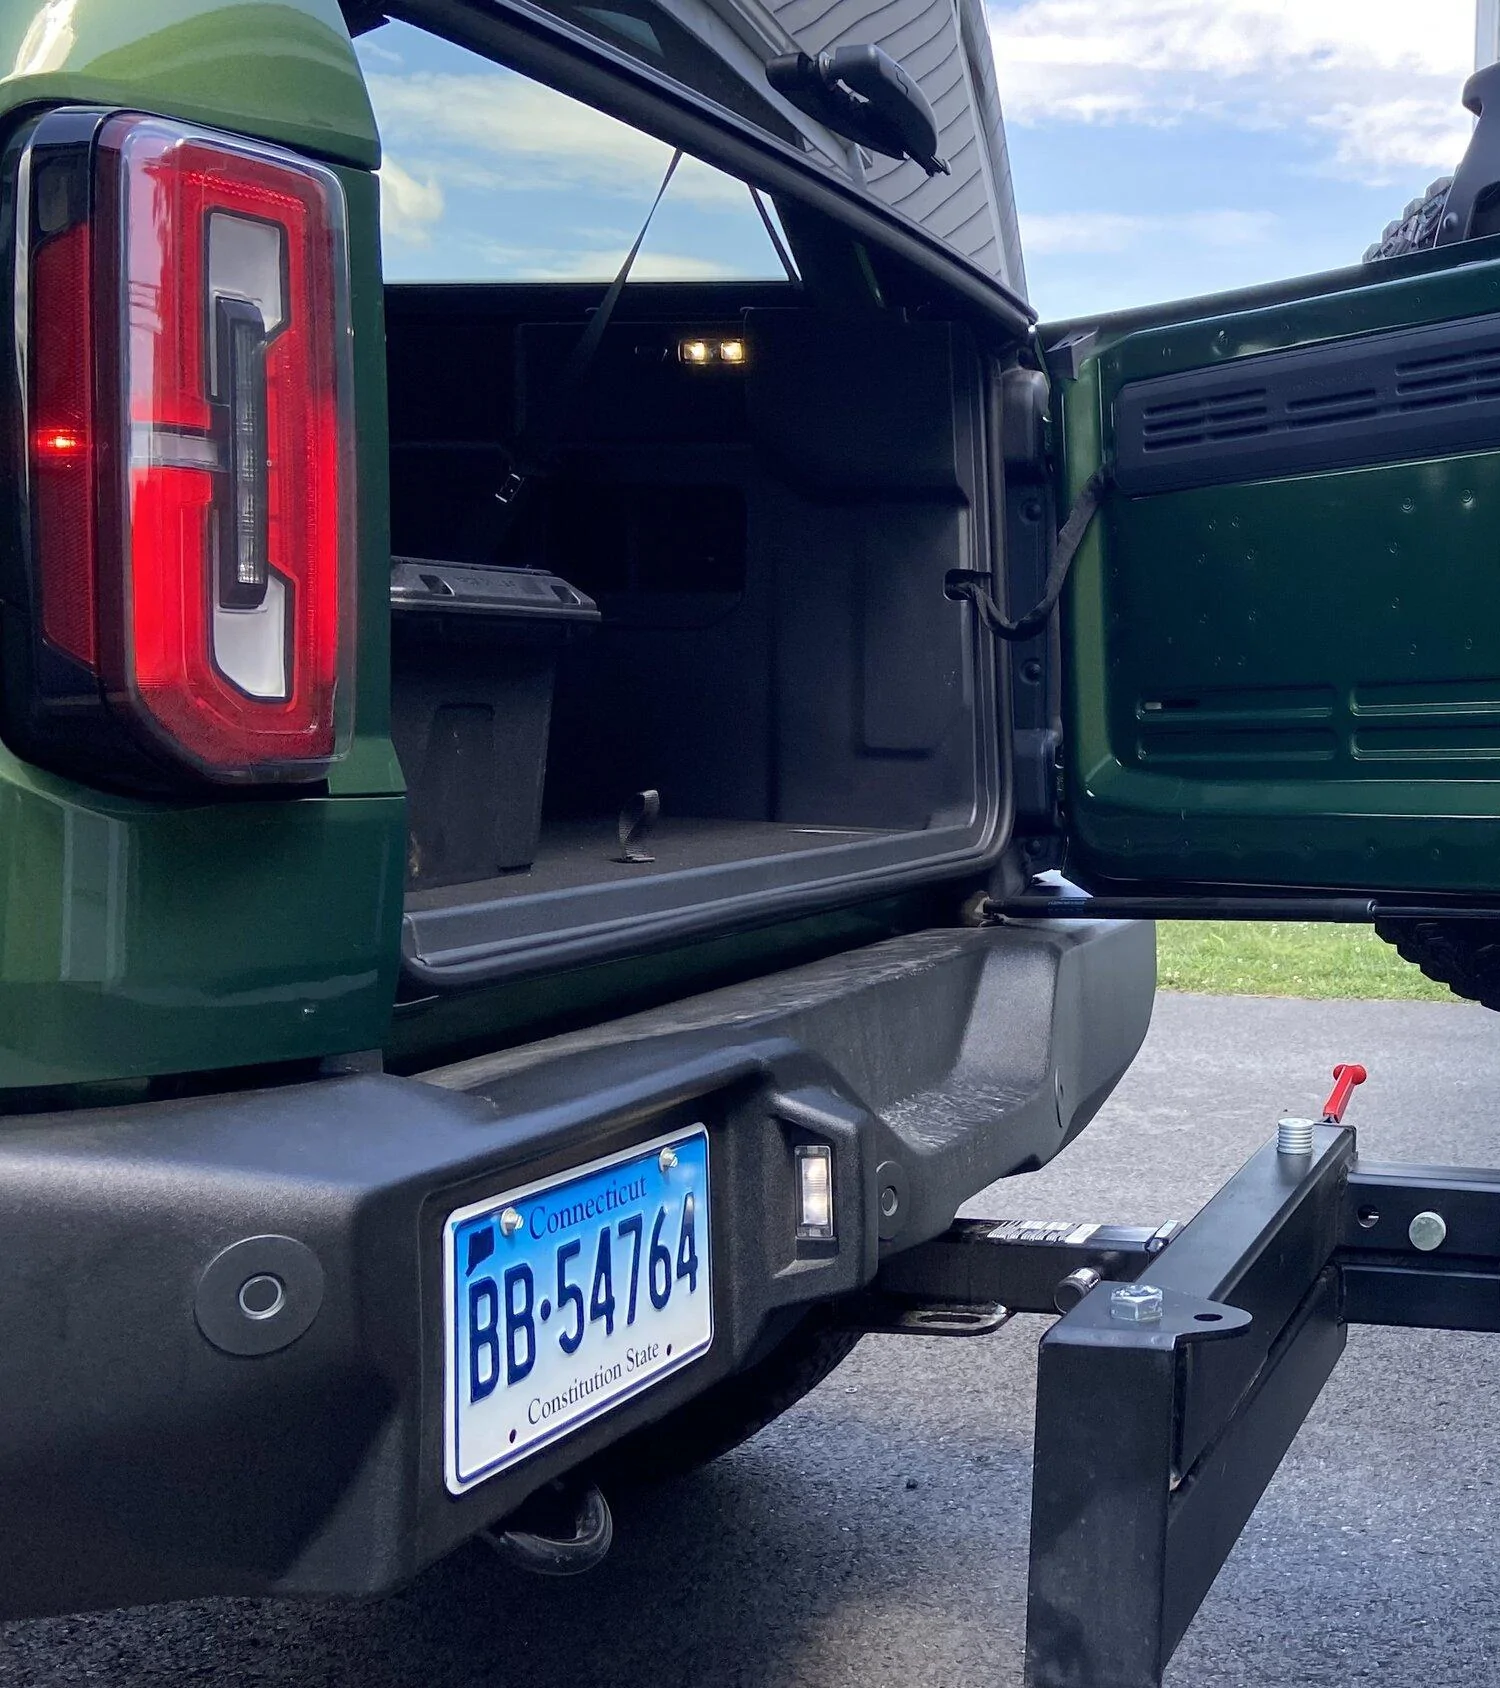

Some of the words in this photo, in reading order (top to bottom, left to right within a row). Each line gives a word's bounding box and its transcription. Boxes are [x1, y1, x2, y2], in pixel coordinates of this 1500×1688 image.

[529, 1175, 648, 1240] Connecticut
[527, 1361, 623, 1425] Constitution
[625, 1342, 660, 1373] State
